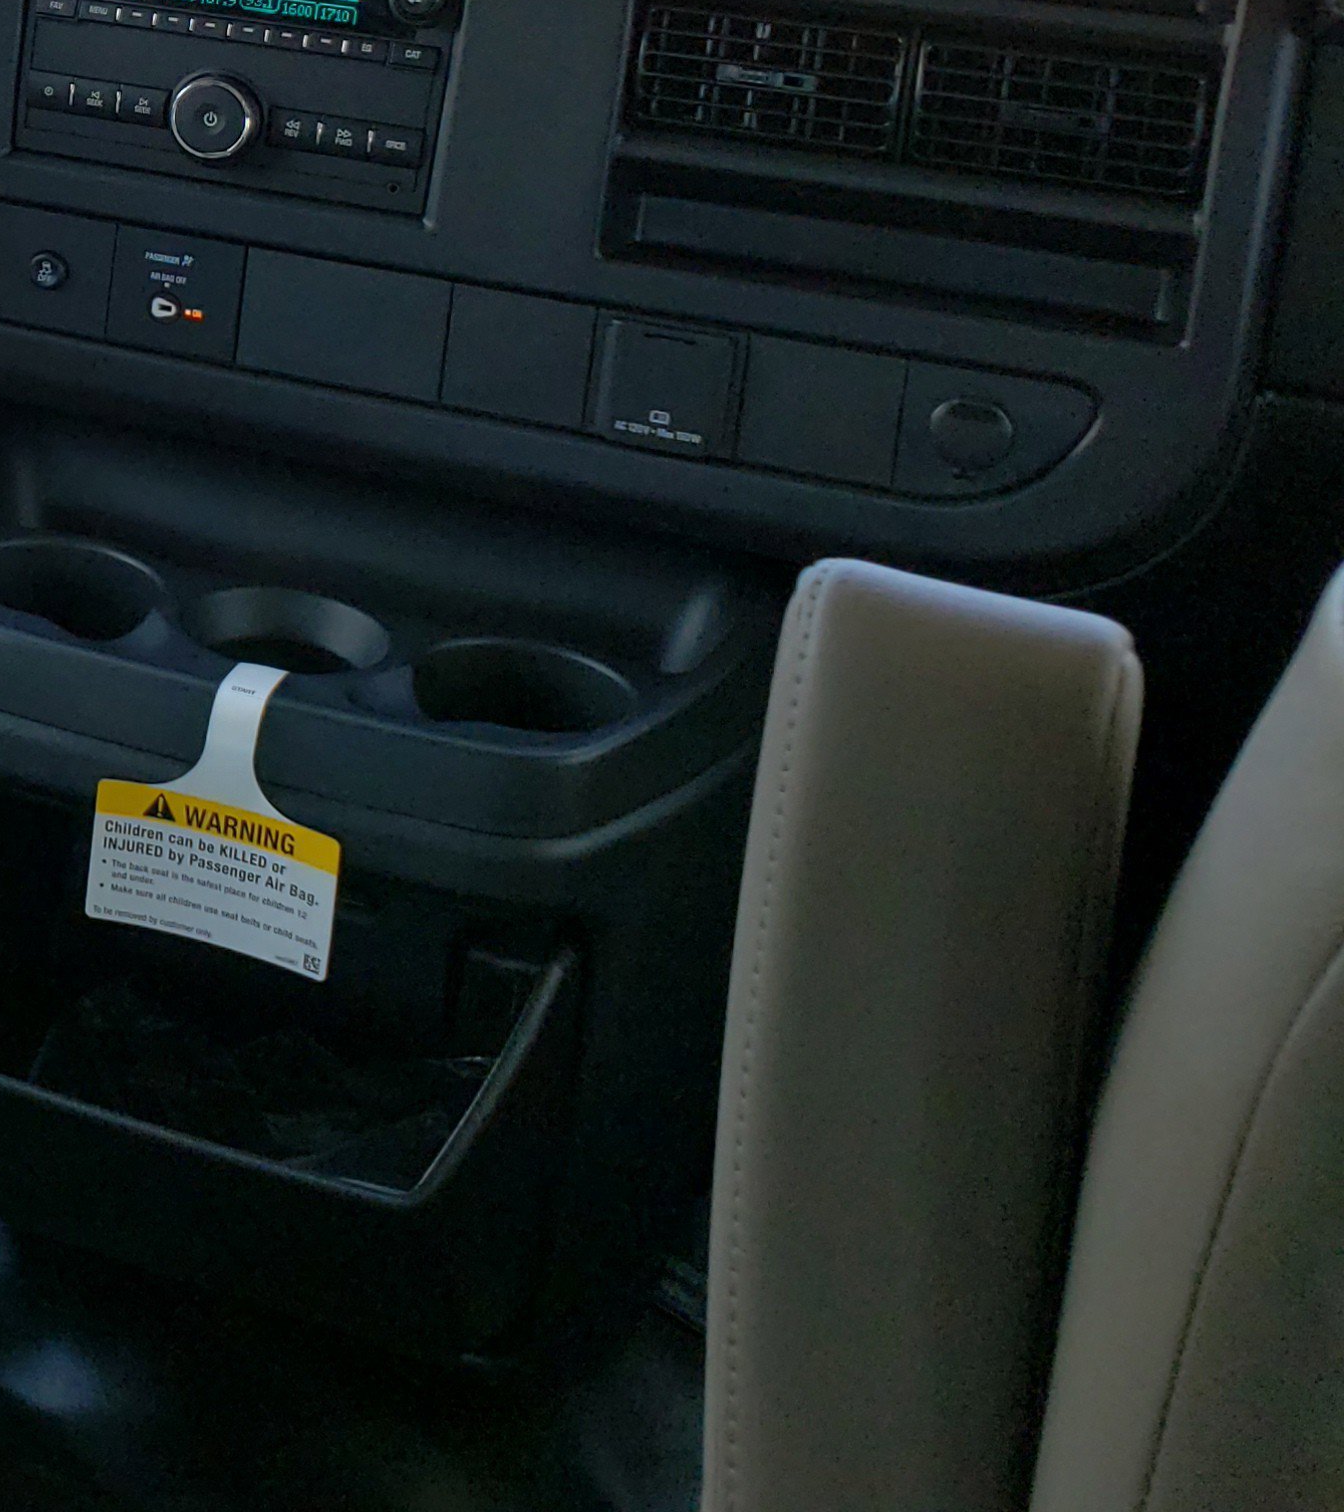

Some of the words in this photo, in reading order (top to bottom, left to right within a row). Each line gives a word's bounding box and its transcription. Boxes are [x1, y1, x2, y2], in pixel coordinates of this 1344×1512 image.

[282, 2, 313, 18] 1600
[320, 7, 350, 23] 1710
[405, 49, 422, 60] CAT
[105, 820, 164, 841] Children
[169, 834, 194, 848] can
[199, 838, 215, 854] be
[220, 844, 268, 869] KILLED
[272, 862, 287, 875] or
[185, 804, 296, 856] WARNING
[103, 836, 164, 858] INJURED
[169, 848, 185, 865] by
[189, 853, 262, 884] Passenger
[265, 876, 286, 893] Air
[289, 883, 319, 907] Bag.
[112, 871, 127, 880] and
[112, 859, 127, 869] The
[129, 862, 148, 873] back
[181, 874, 194, 883] the
[197, 877, 222, 891] safest
[224, 886, 246, 897] place
[248, 892, 260, 902] for
[262, 897, 295, 914] children
[298, 909, 308, 920] 12
[93, 904, 102, 914] To
[104, 906, 113, 915] be
[115, 909, 147, 922] removed
[149, 915, 158, 925] by
[160, 918, 194, 932] customer
[111, 883, 133, 894] Make
[136, 889, 153, 899] sure
[156, 893, 166, 902] all
[169, 895, 202, 910] children
[204, 905, 218, 915] use
[221, 910, 238, 921] seat
[241, 914, 261, 928] belts
[263, 923, 272, 932] or
[274, 926, 293, 940] child
